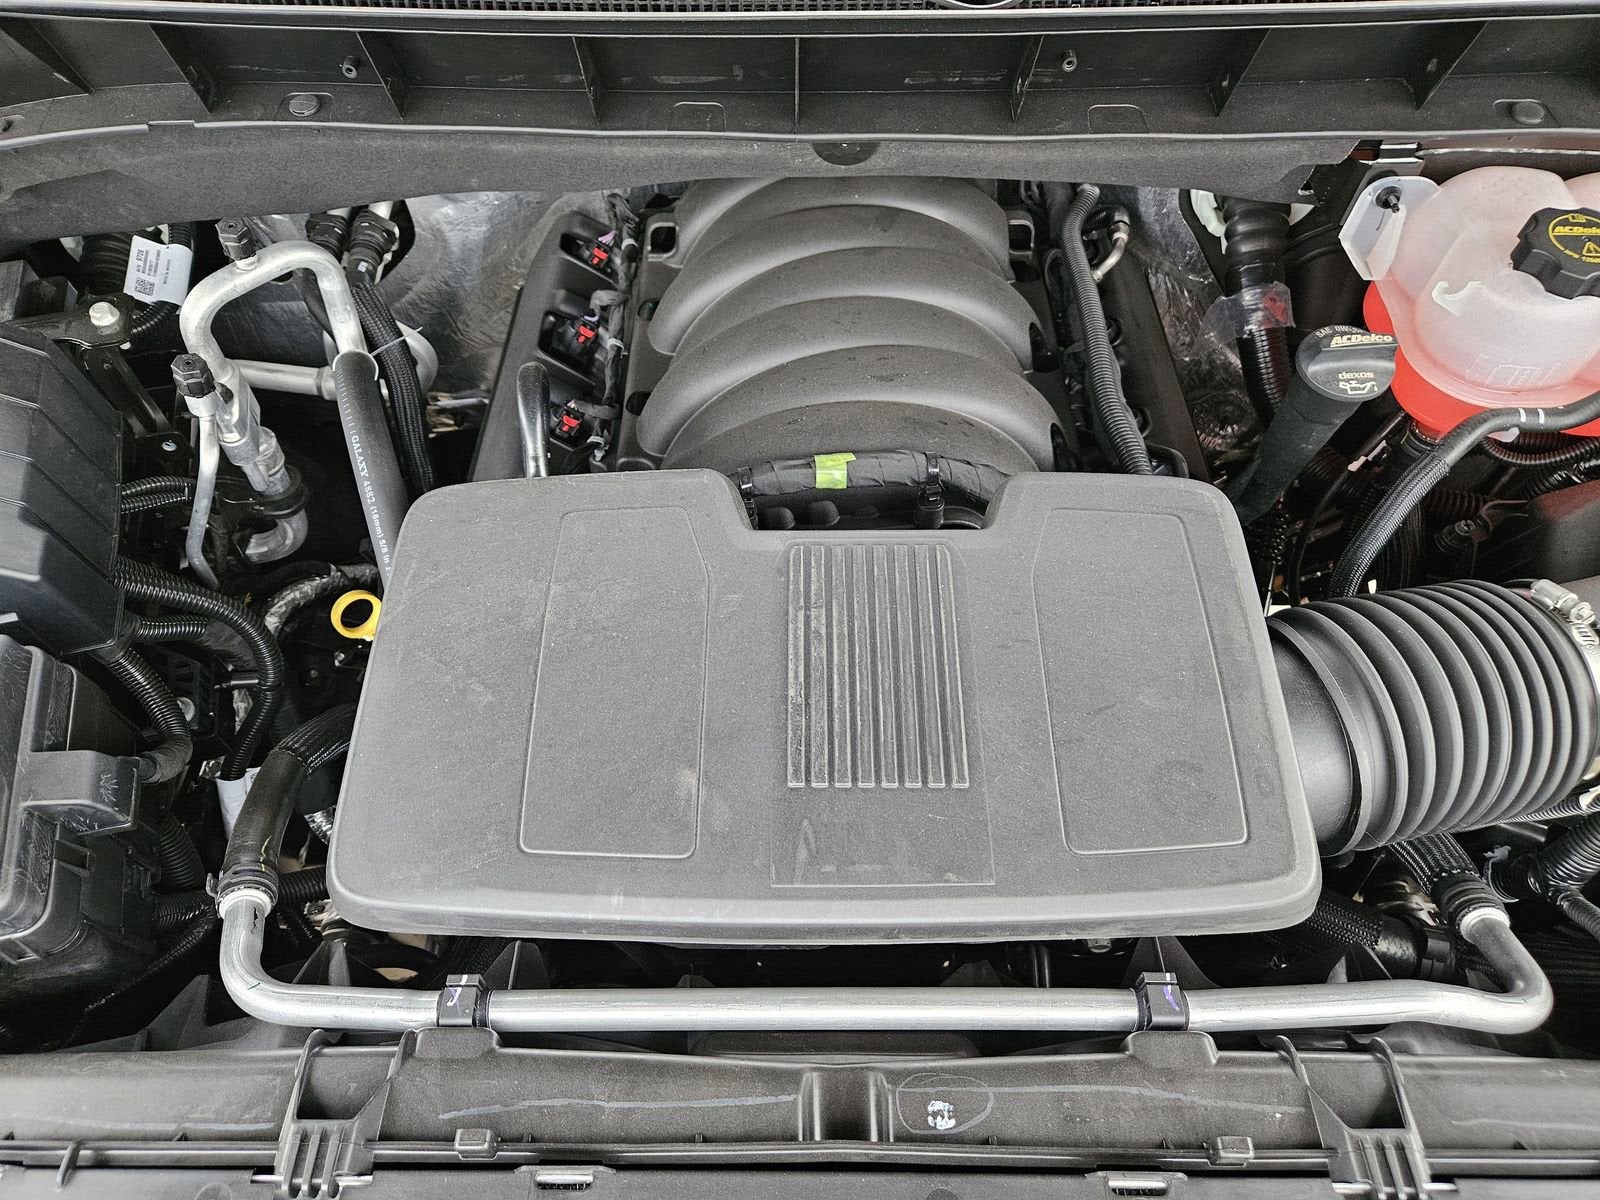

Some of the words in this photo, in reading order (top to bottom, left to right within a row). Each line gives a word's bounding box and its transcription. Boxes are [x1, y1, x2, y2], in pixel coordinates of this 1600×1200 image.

[1315, 327, 1333, 338] SAE
[1330, 333, 1393, 346] ACDelco
[1338, 371, 1374, 380] dexos
[351, 435, 369, 477] GALAXY
